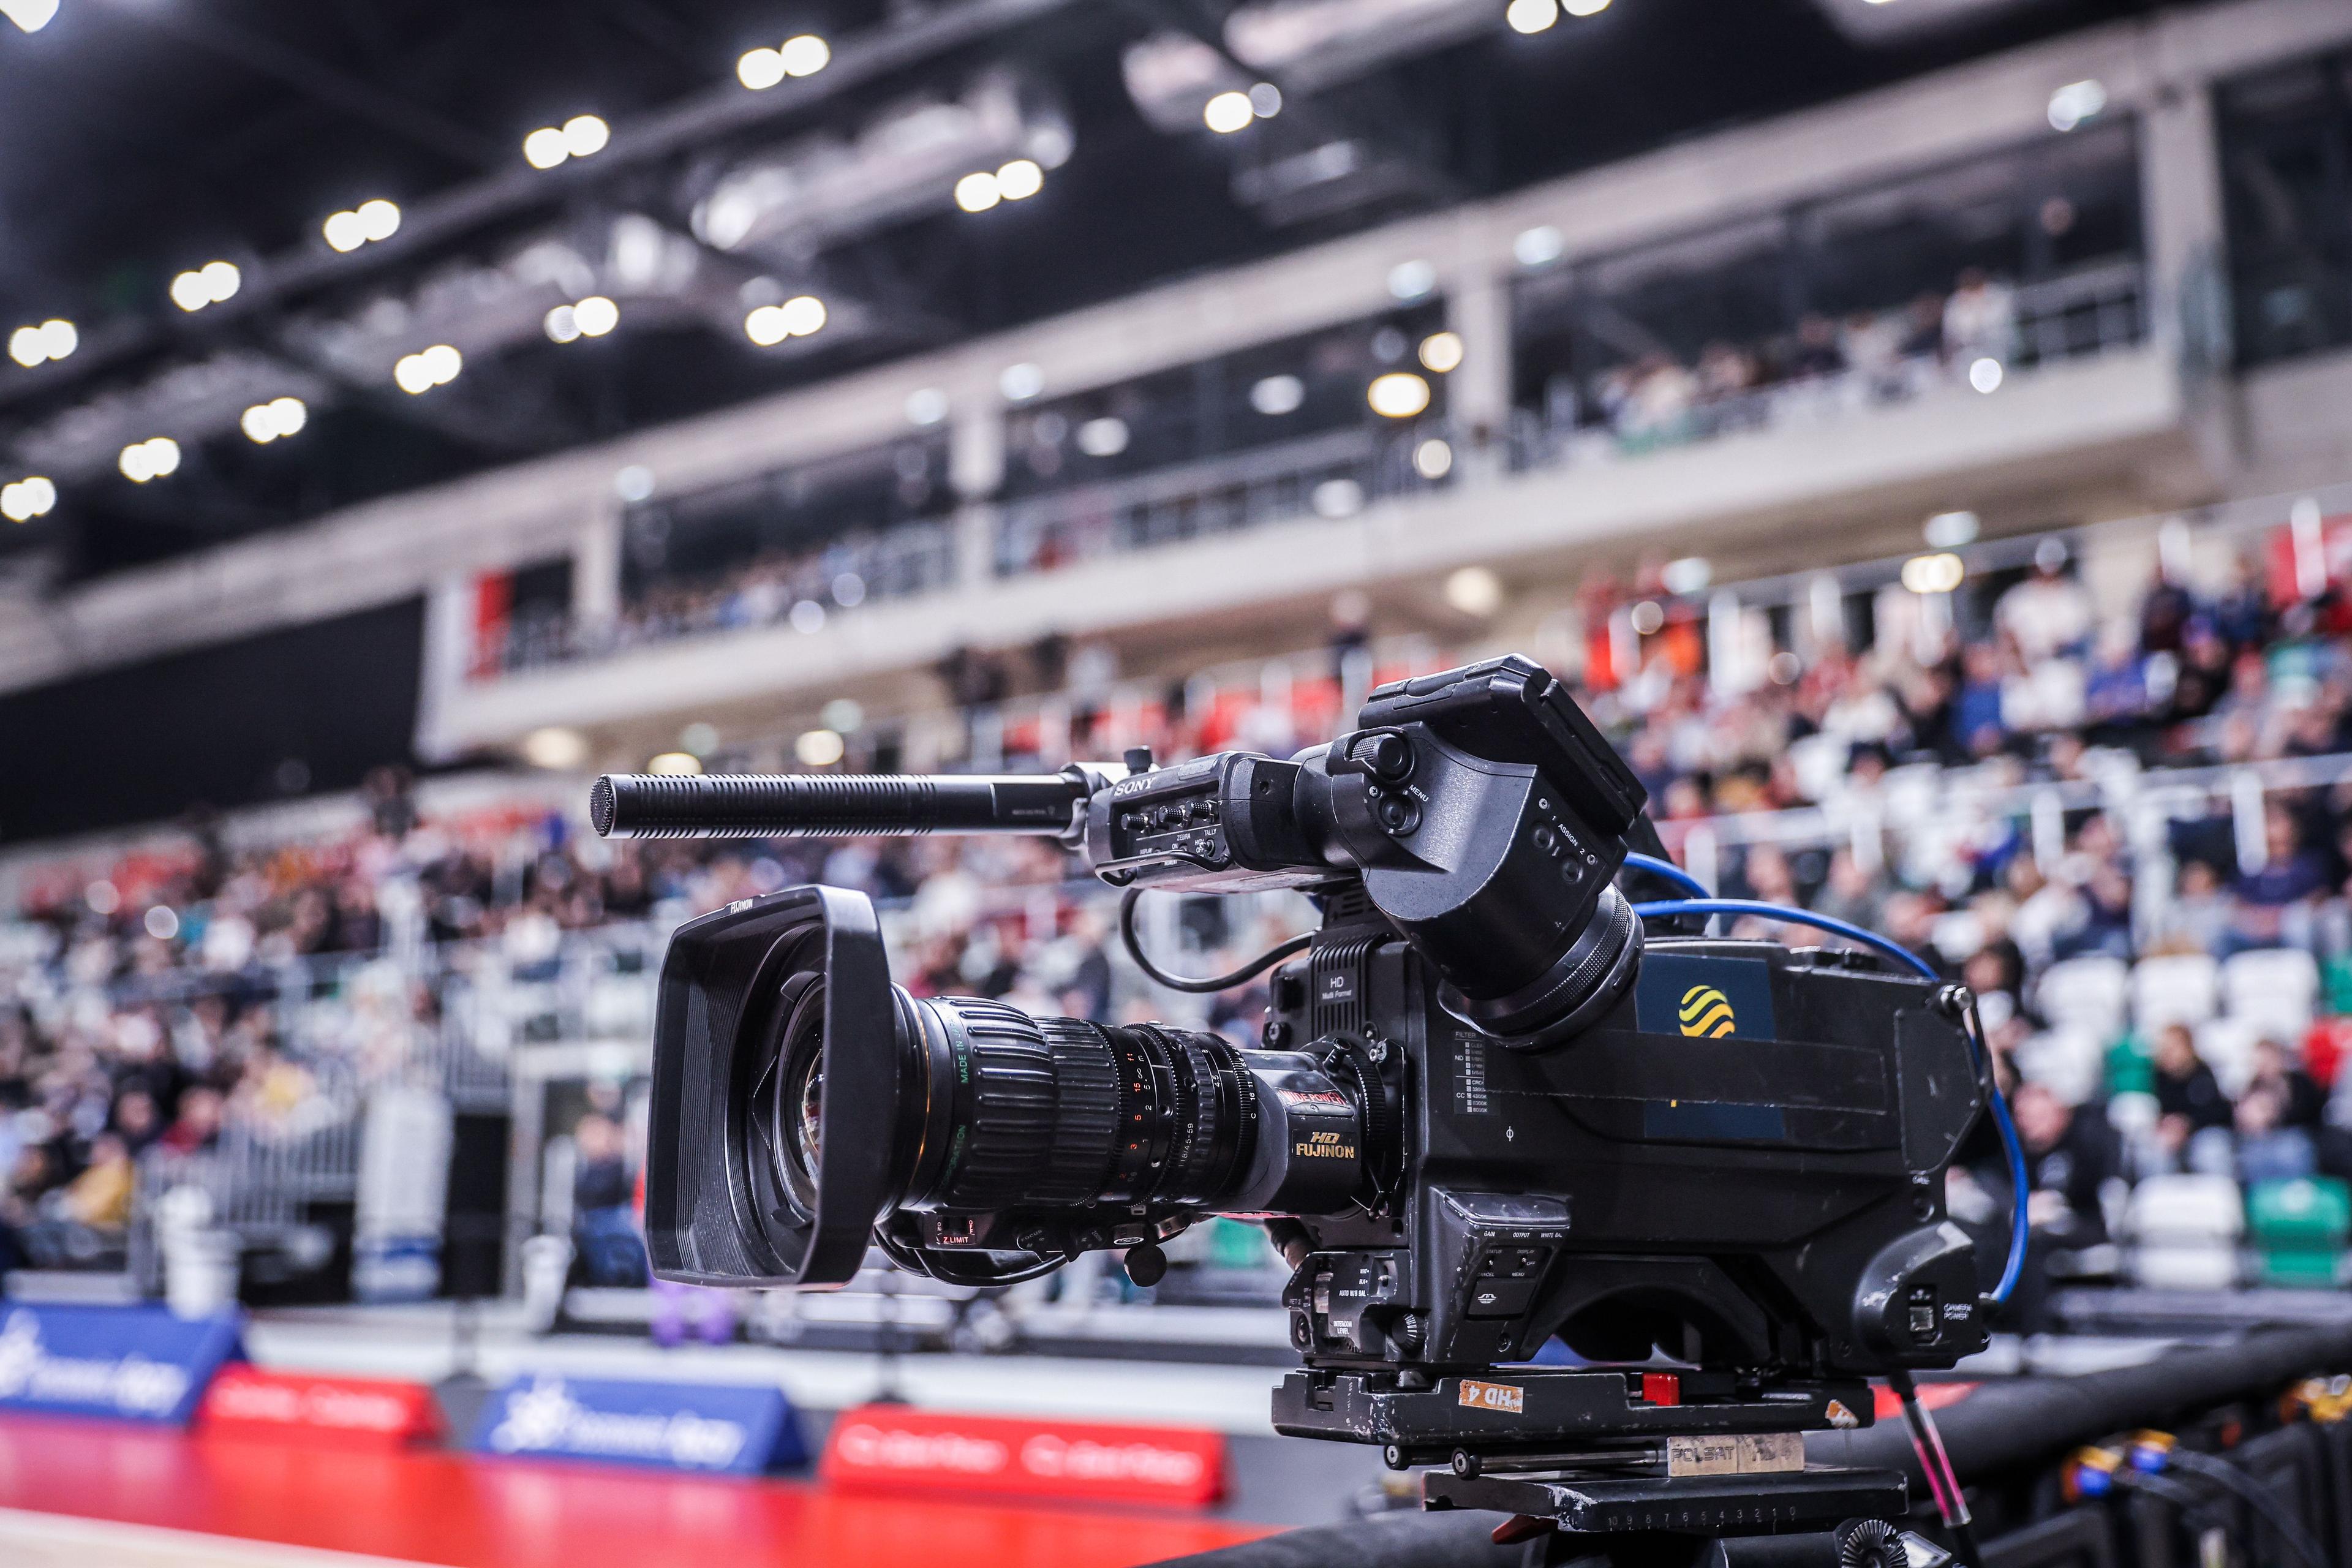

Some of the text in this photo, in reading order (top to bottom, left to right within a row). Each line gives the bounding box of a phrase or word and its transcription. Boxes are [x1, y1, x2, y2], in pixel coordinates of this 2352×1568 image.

[1114, 777, 1156, 796] SONY
[1409, 785, 1429, 802] MENU
[1558, 824, 1578, 846] ASSIGN
[731, 898, 753, 914] FUJINON
[1330, 976, 1344, 989] HD
[956, 1041, 965, 1050] IN
[959, 1054, 968, 1084] MADE
[1134, 1082, 1141, 1092] 15
[1250, 1092, 1256, 1101] 16
[1281, 1090, 1346, 1106] WIDE POWER
[1310, 1131, 1341, 1144] HD
[940, 1125, 966, 1188] ORPORATION
[1296, 1143, 1354, 1159] FUJINON
[937, 1222, 941, 1231] ON
[1943, 1303, 1972, 1312] CAMERA
[1943, 1311, 1969, 1320] POWER
[1469, 1385, 1512, 1406] HD 4
[1671, 1446, 1734, 1462] POLSAT
[1608, 1506, 1796, 1526] 10 9 8 7 6 5 4 3 2 1 0
